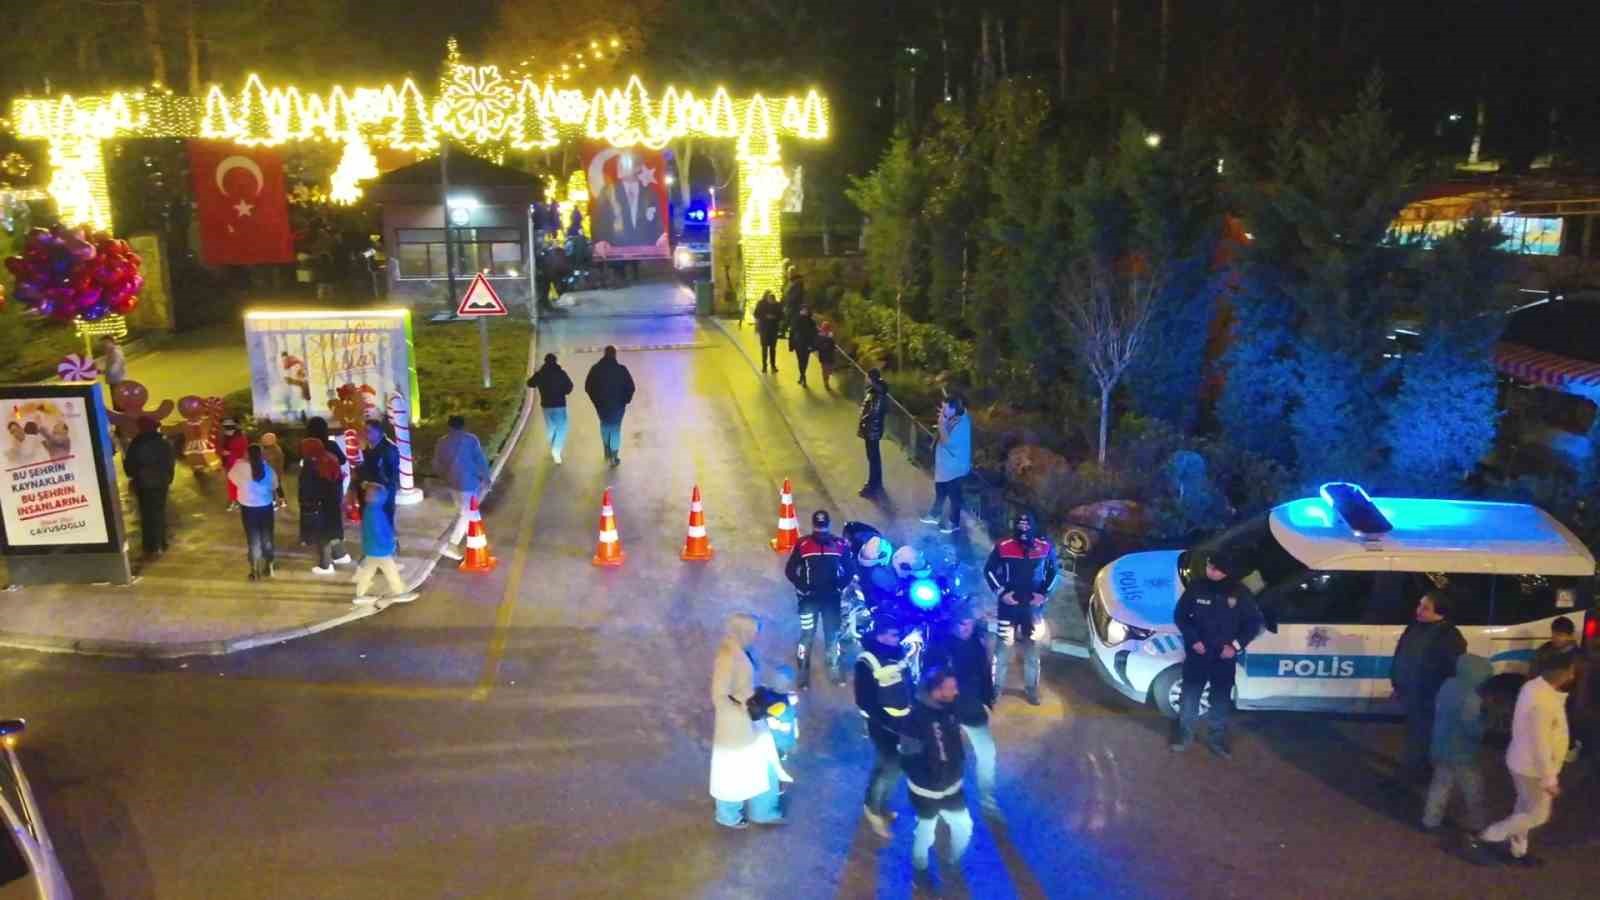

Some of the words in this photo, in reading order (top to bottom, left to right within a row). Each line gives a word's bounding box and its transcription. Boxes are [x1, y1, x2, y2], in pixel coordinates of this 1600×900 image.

[11, 473, 75, 492] KAYNAKLARI
[12, 471, 26, 480] BU
[21, 494, 35, 503] BU
[1277, 656, 1355, 676] POLİS
